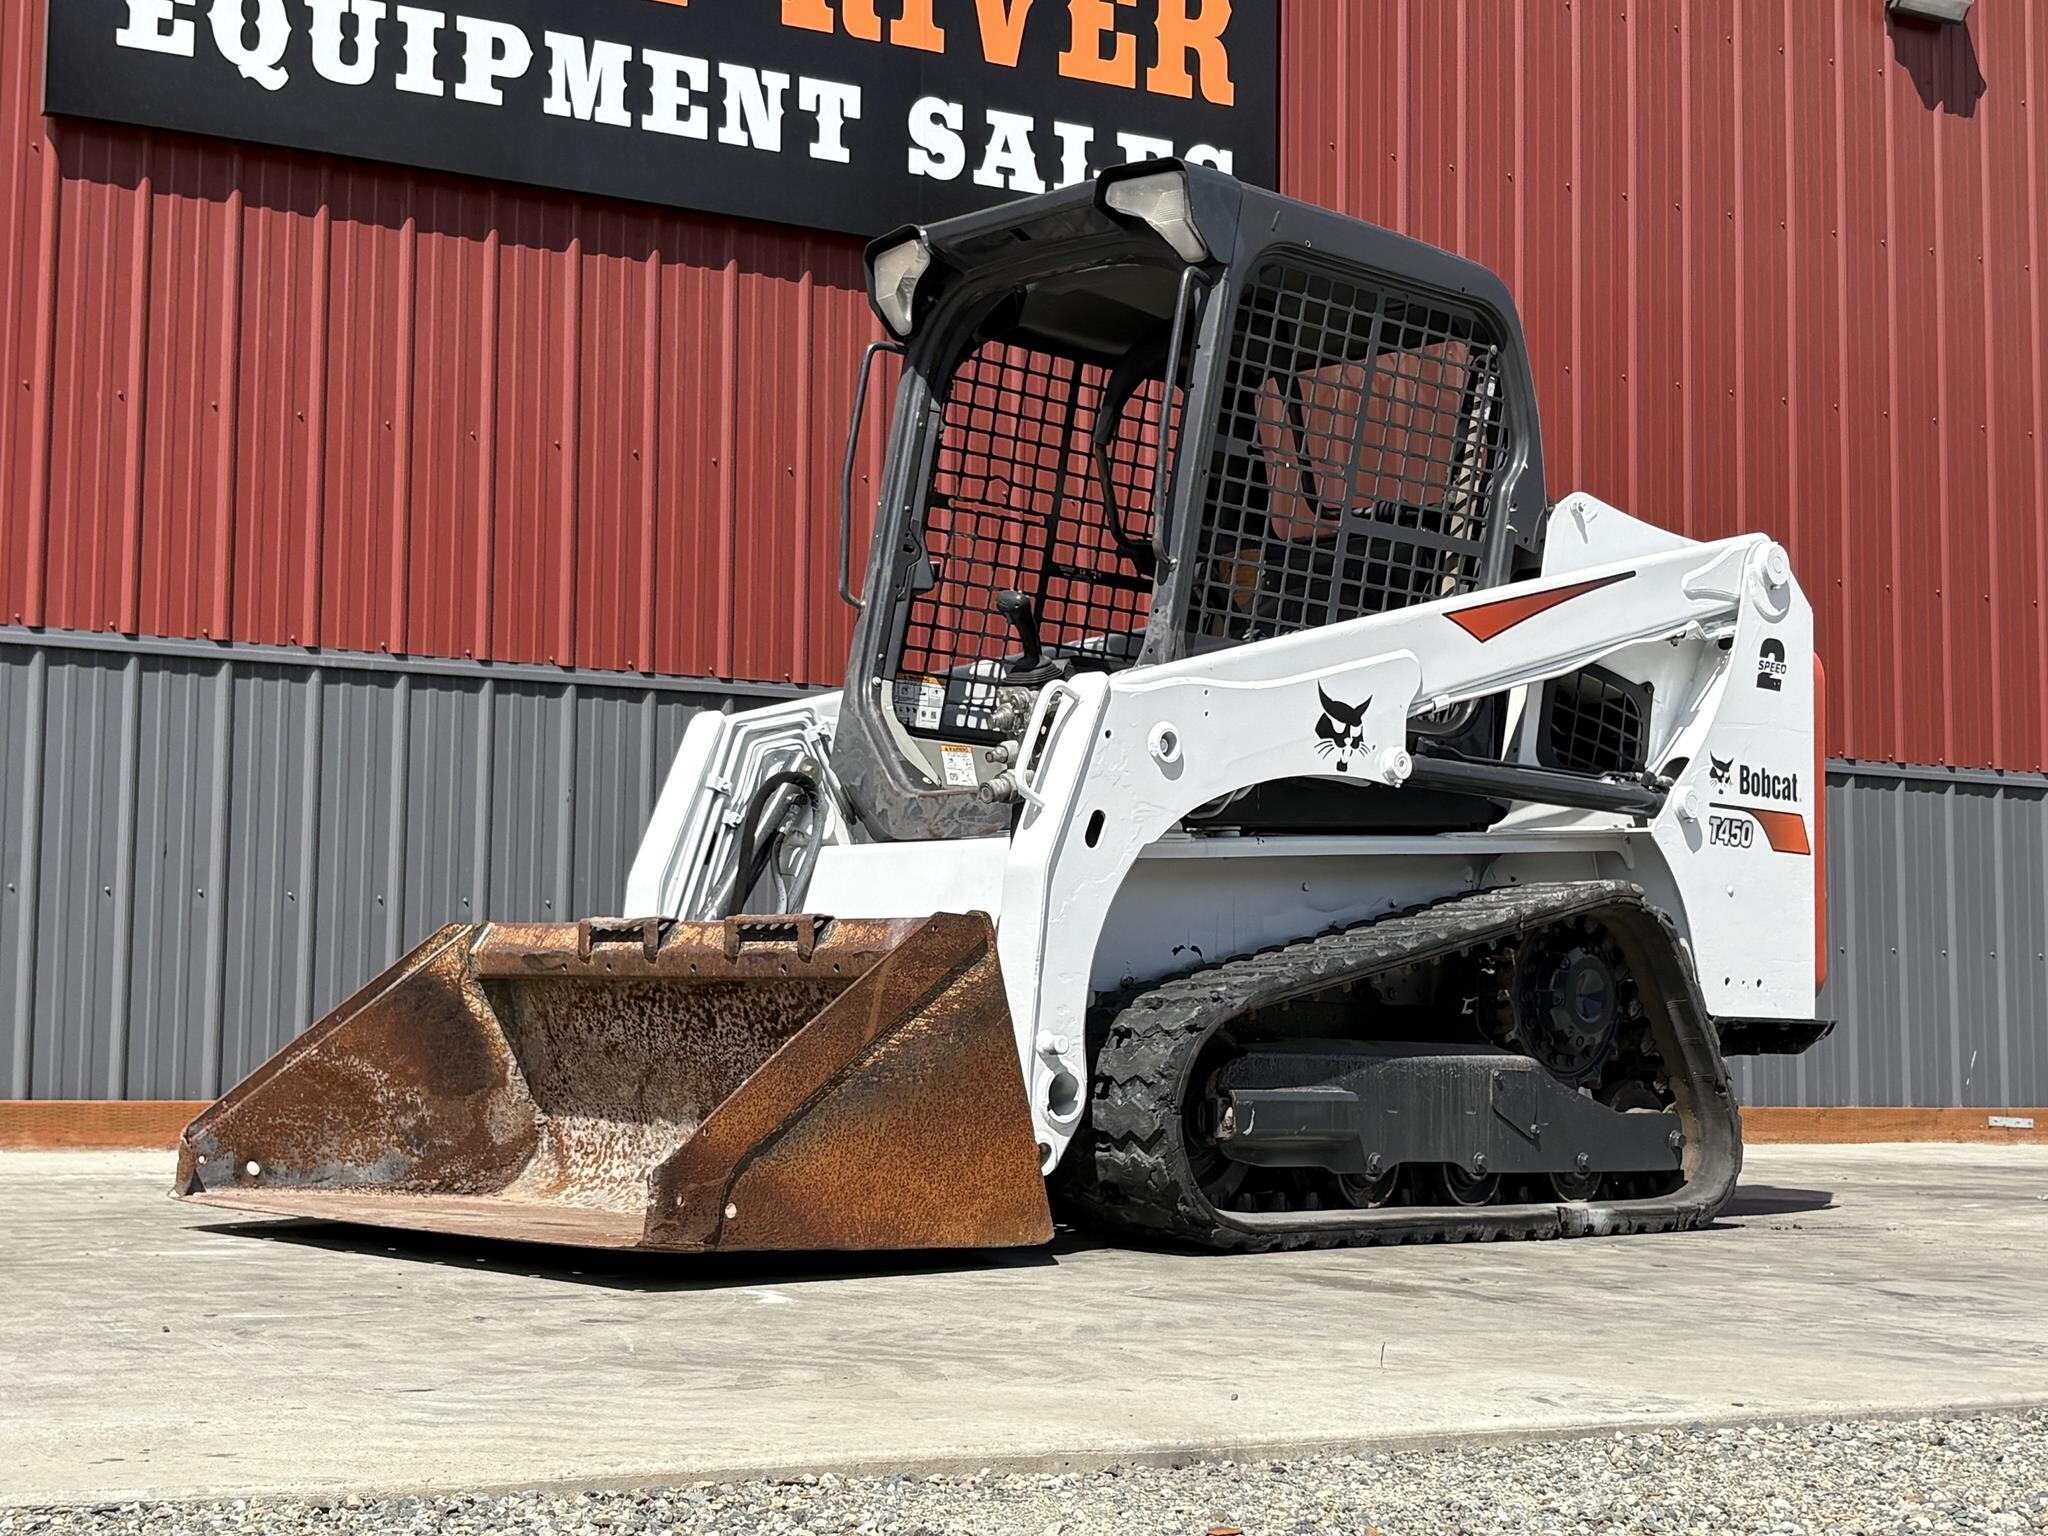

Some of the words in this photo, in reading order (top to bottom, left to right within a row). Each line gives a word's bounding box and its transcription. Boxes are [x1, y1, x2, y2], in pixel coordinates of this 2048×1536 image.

[781, 0, 1235, 106] VER
[116, 0, 861, 164] EQUIPMENT
[1758, 660, 1787, 674] SPEED
[1739, 765, 1798, 802] Bobcat
[1709, 816, 1753, 848] T450
